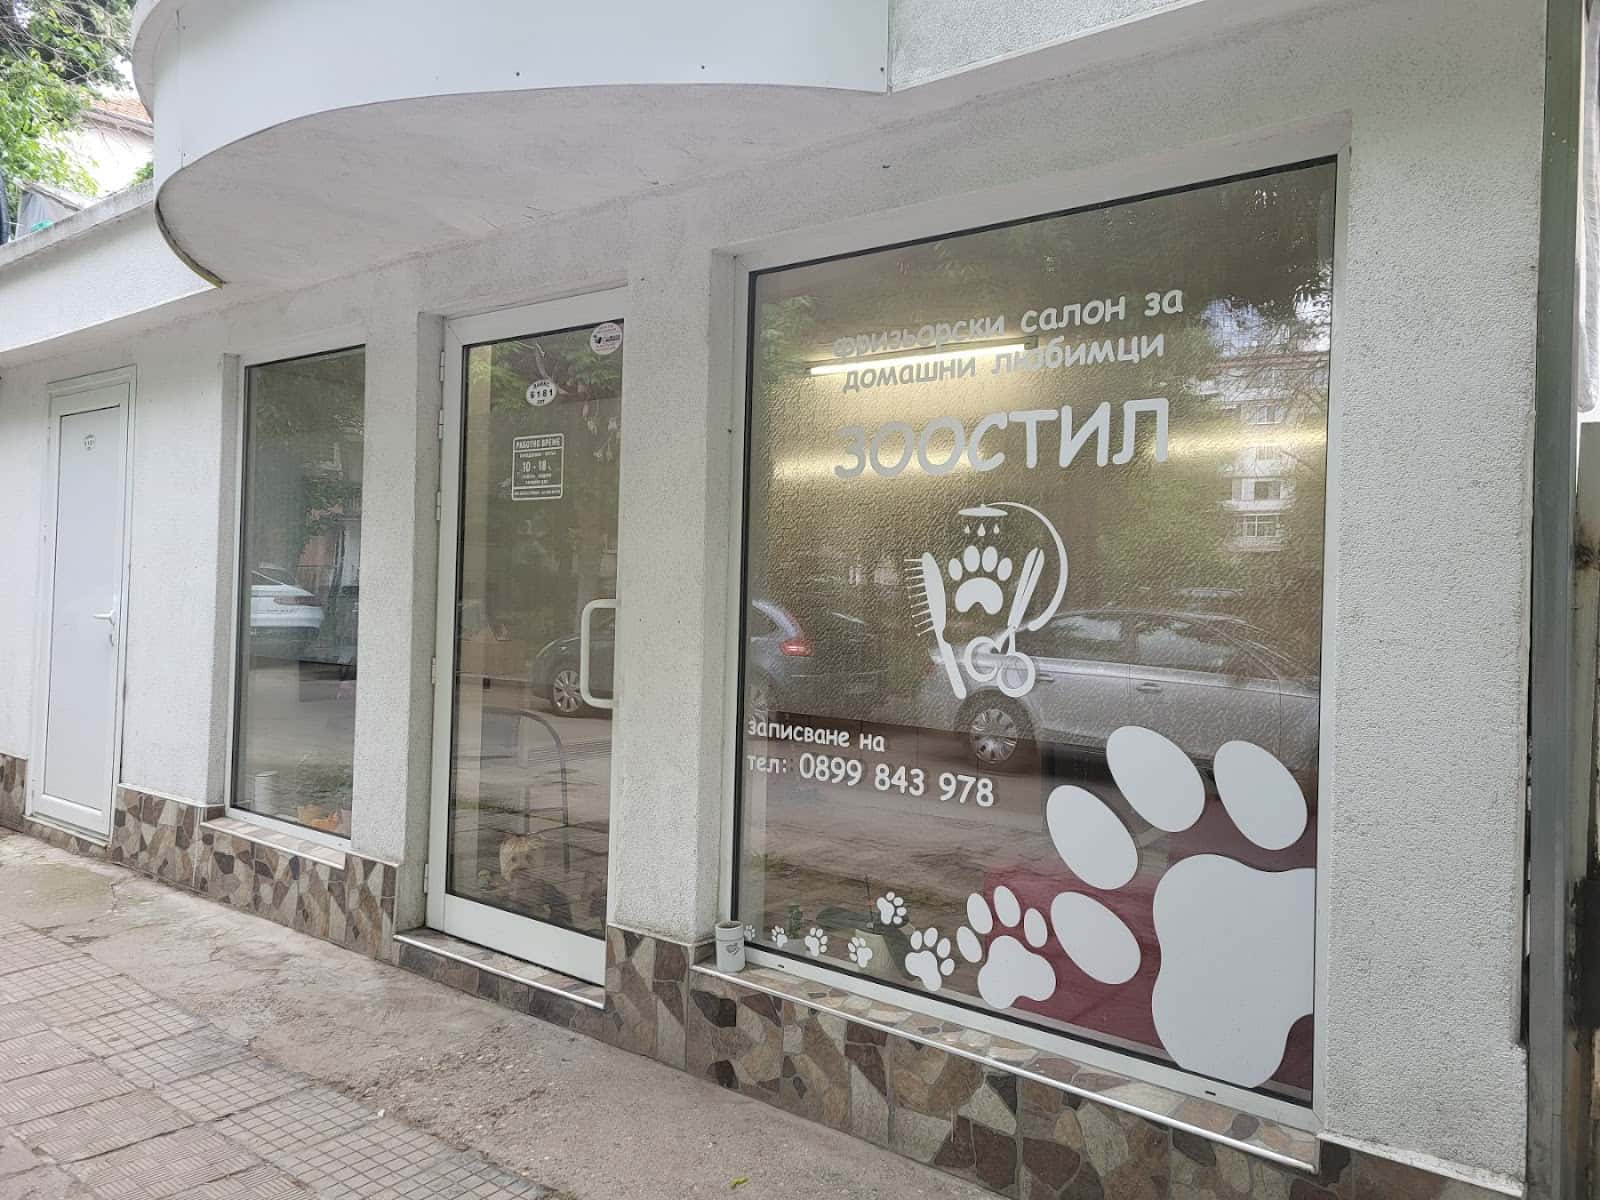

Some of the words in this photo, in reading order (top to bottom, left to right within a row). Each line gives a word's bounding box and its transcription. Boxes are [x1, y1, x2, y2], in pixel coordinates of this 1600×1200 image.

[832, 314, 1005, 358] фризьорски
[1020, 295, 1126, 333] салон
[1143, 289, 1184, 317] за
[842, 357, 976, 394] домашни
[992, 333, 1165, 374] любимци
[834, 397, 1169, 479] ЗООСТИЛ
[748, 719, 850, 748] записване
[859, 733, 885, 752] на
[747, 754, 787, 774] тел:
[799, 752, 863, 787] 0899
[874, 763, 925, 797] 843
[938, 772, 994, 807] 978
